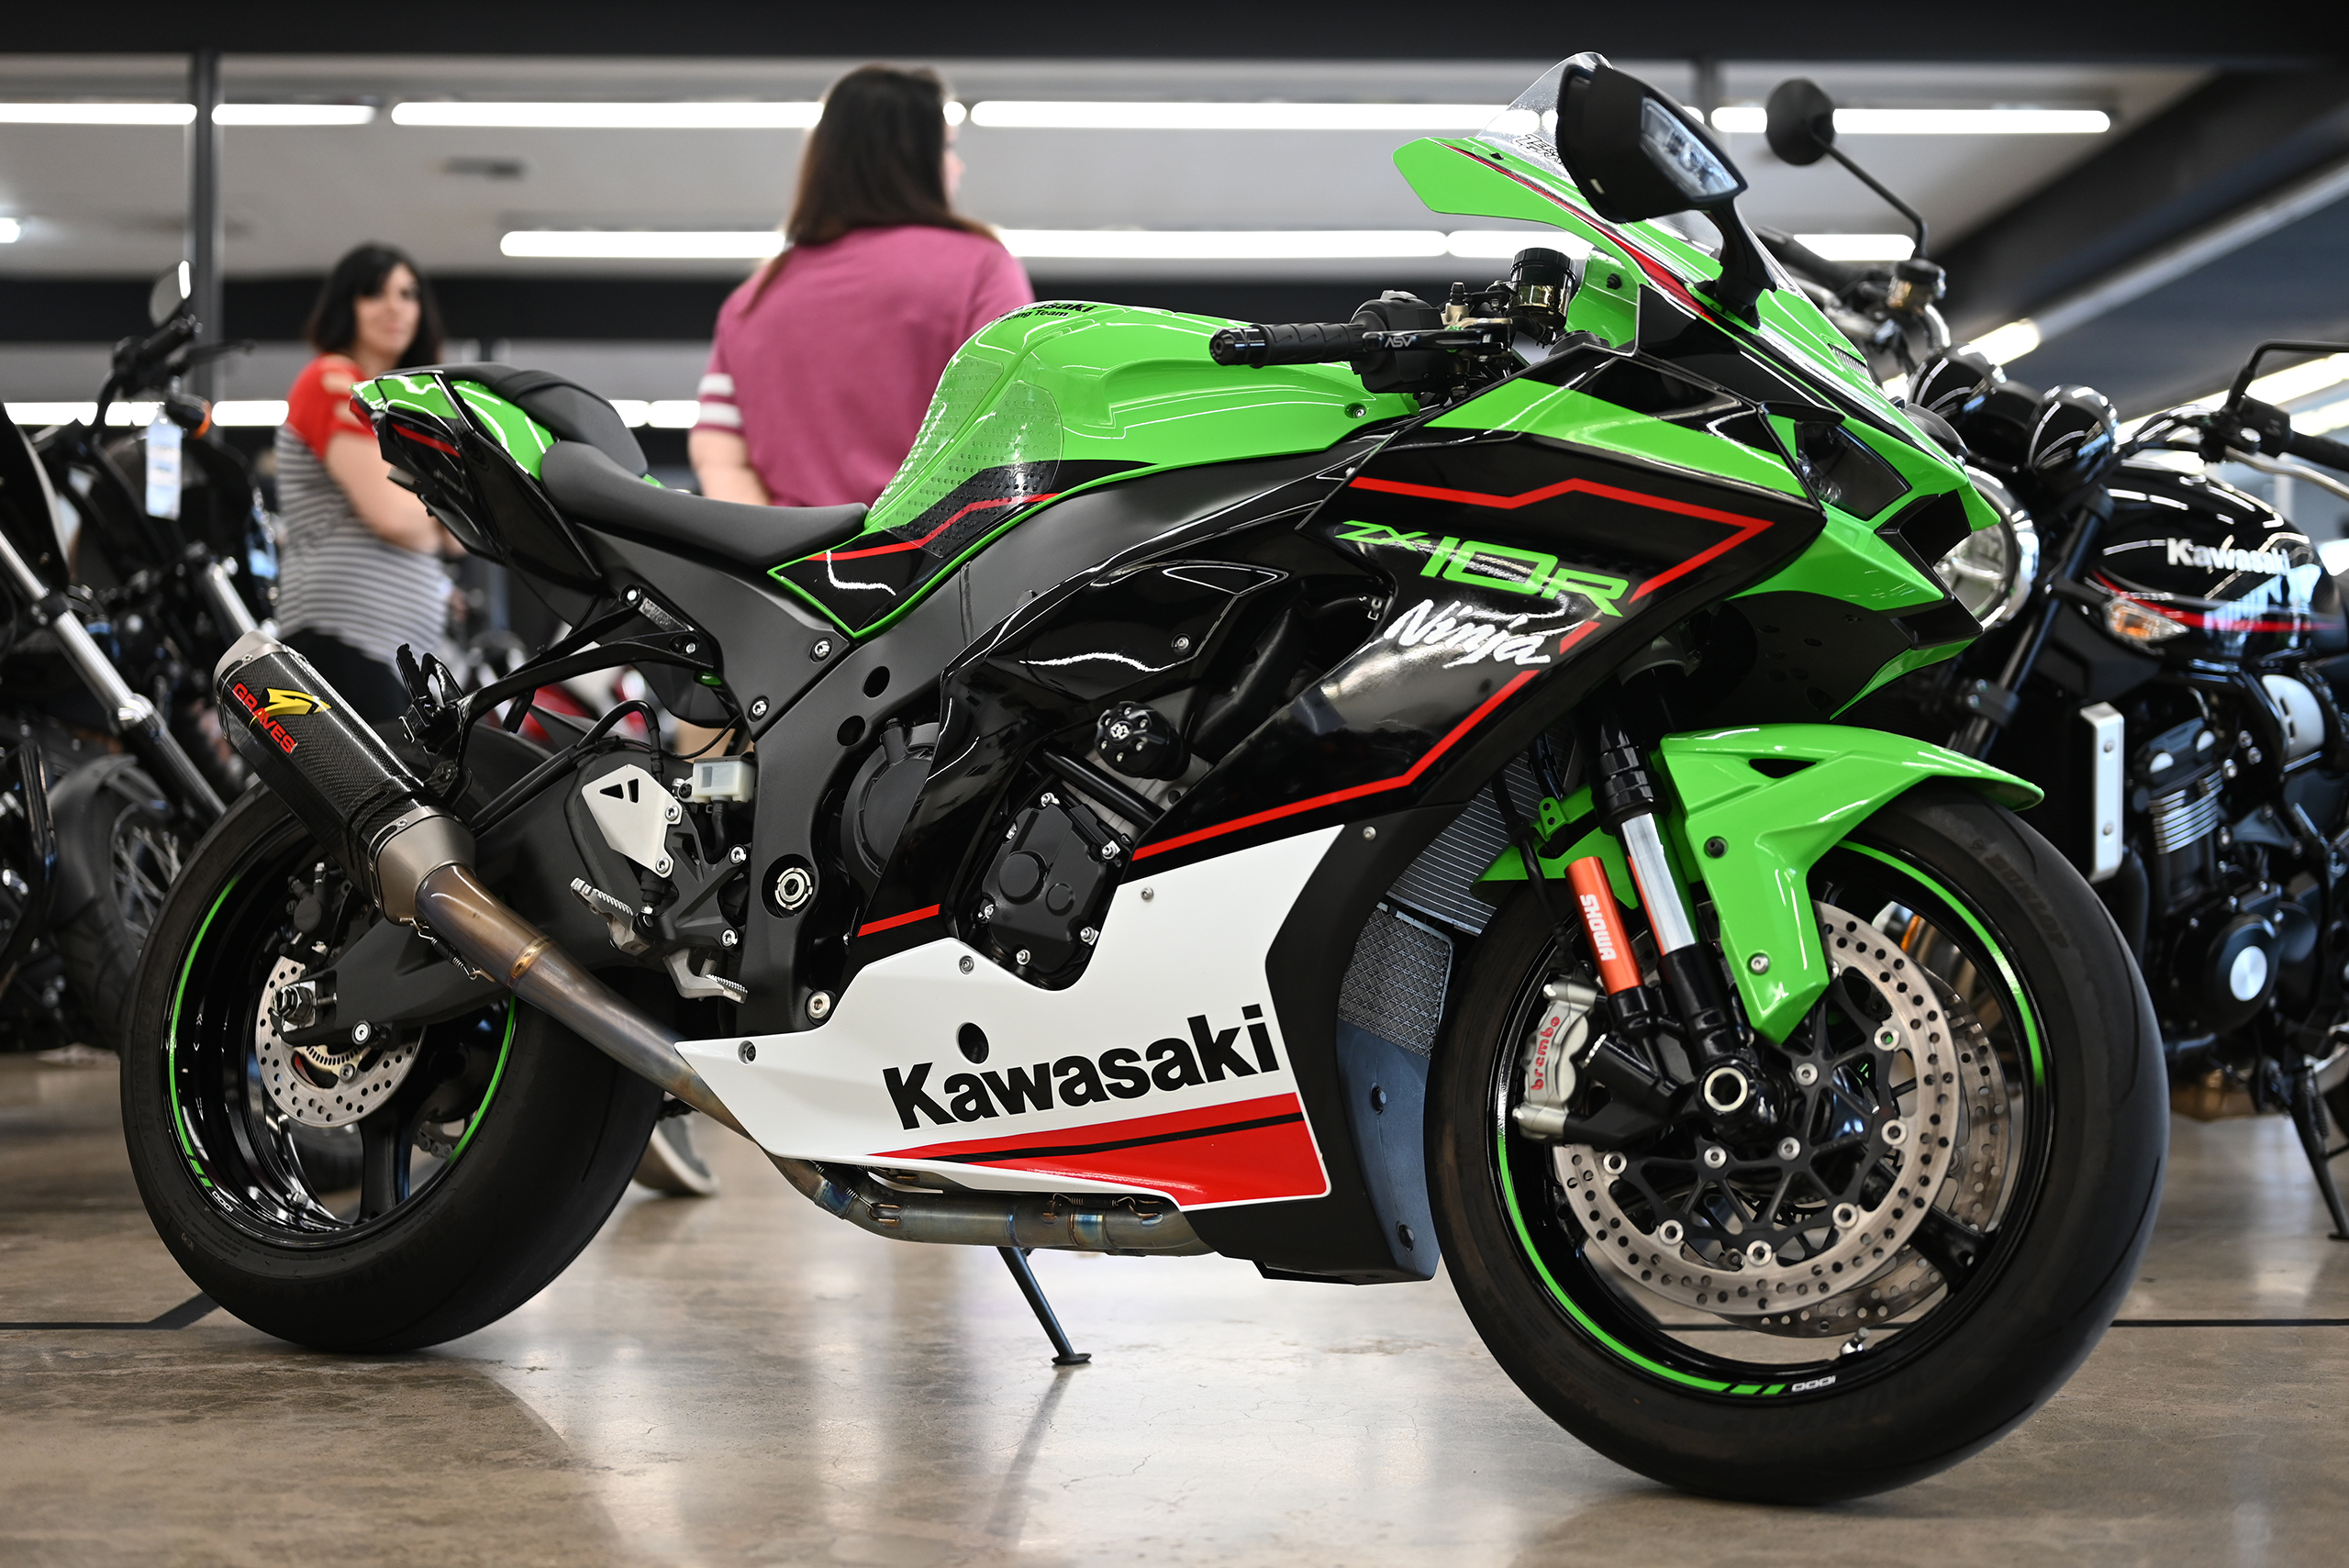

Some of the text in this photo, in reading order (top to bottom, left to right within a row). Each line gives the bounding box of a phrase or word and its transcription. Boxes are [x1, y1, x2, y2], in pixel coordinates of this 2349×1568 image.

[1034, 309, 1069, 317] Team
[1384, 335, 1414, 349] ASV
[1334, 519, 1630, 617] ZX-10R
[2166, 537, 2291, 576] Kawasaki
[1383, 598, 1551, 669] Ninja
[232, 683, 298, 754] GRAVES
[1579, 894, 1618, 962] SHOWA
[882, 1003, 1280, 1131] Kawasaki
[1531, 1015, 1561, 1091] brembo
